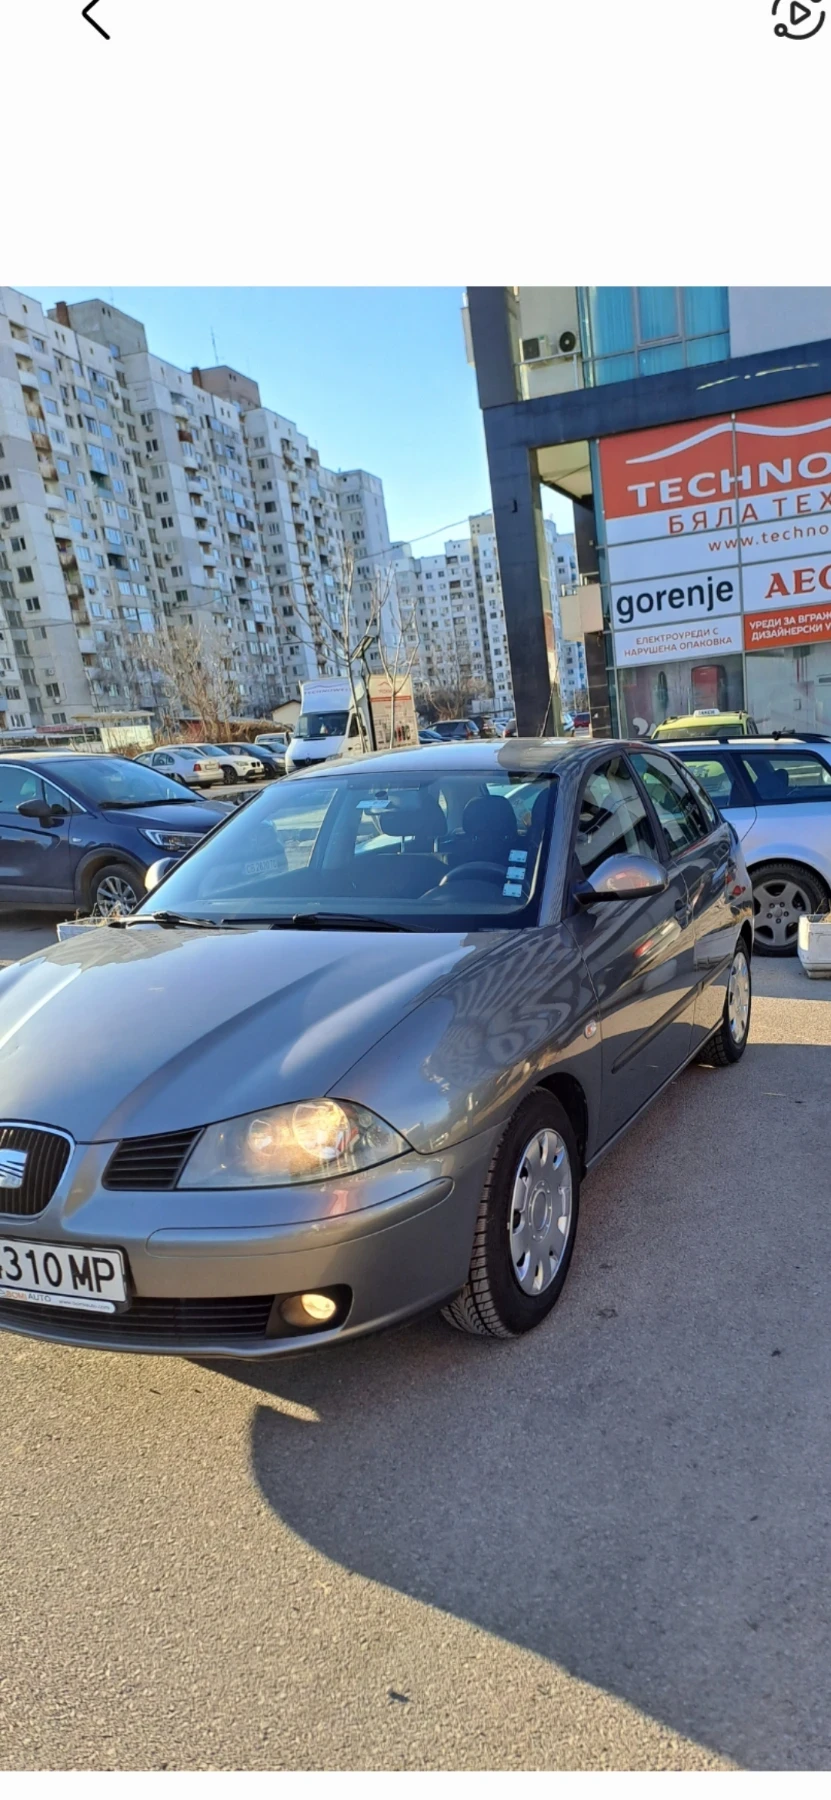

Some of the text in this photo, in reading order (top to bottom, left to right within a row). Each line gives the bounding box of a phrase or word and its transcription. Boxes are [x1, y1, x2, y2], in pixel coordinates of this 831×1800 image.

[627, 452, 831, 508] TECHNO
[669, 503, 758, 535] БЯЛА
[708, 525, 829, 552] www.techno
[616, 576, 734, 623] gorenje
[749, 619, 781, 630] УРЕДИ
[783, 616, 796, 626] ЗА
[751, 623, 823, 642] ДИЗАЙНЕРСКИ
[624, 636, 732, 657] НАРУШЕНА ОПАКОВКА
[636, 627, 719, 645] ЕЛЕКТРОУРЕДИ С
[28, 1293, 51, 1302] AUTO
